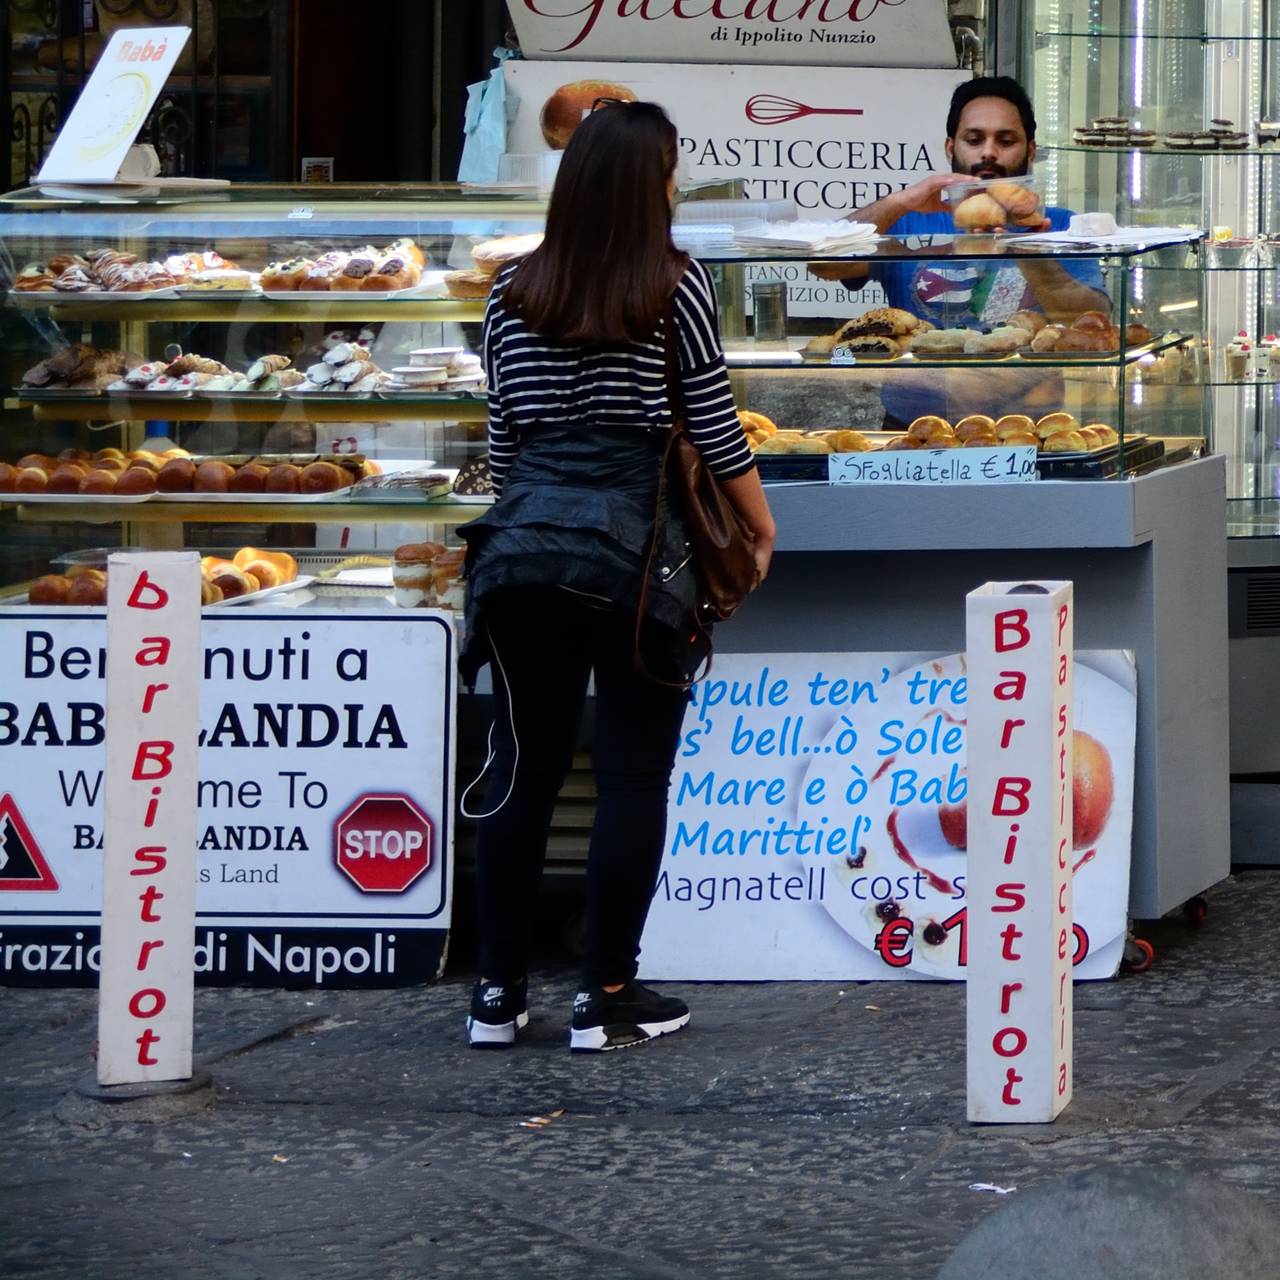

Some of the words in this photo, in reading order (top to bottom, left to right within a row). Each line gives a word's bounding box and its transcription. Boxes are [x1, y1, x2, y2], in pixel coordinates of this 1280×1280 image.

[711, 27, 729, 42] di
[734, 28, 803, 46] Ippolito
[809, 29, 877, 44] Nunzio
[745, 266, 798, 281] TANO
[835, 288, 890, 304] BUFFE
[981, 455, 1000, 479] €
[25, 629, 311, 680] Benuti
[336, 646, 369, 680] a
[993, 608, 1031, 749] Bar
[0, 702, 408, 750] BABANDIA
[877, 714, 963, 756] Sole
[279, 771, 328, 809] To
[677, 771, 786, 806] Mare
[805, 777, 826, 805] e
[846, 764, 868, 805] ò
[889, 763, 967, 806] Bab
[344, 830, 423, 859] STOP
[1057, 604, 1070, 1097] Pasticceria
[221, 863, 279, 884] Land
[851, 871, 928, 900] cost
[129, 740, 174, 1066] Bistrot
[194, 931, 228, 972] di
[247, 932, 397, 984] Napoli
[874, 916, 914, 968] €
[991, 776, 1031, 1106] Bistrot
